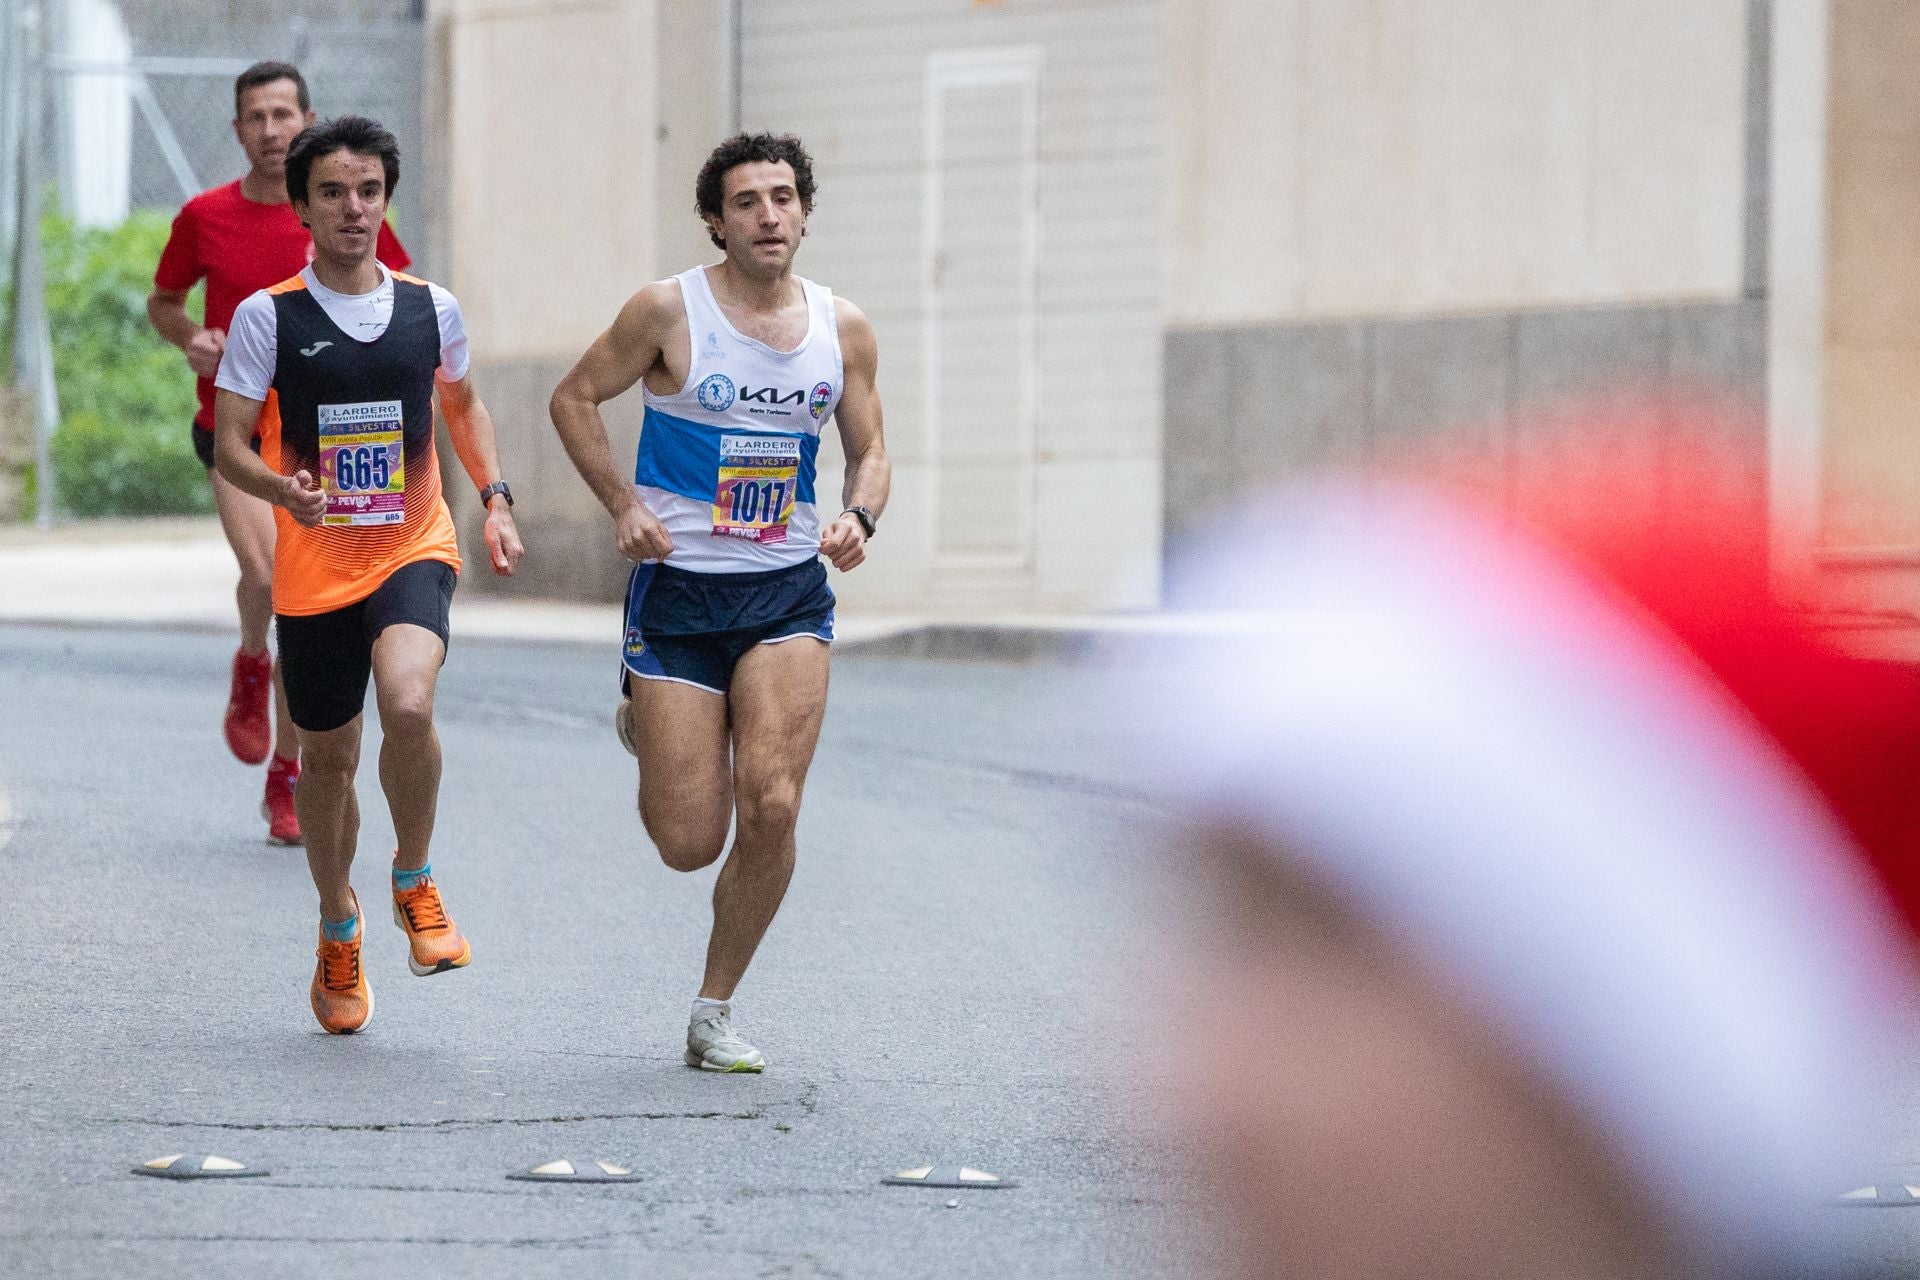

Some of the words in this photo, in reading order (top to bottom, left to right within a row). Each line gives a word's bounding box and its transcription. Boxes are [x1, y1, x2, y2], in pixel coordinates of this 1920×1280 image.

[740, 385, 805, 406] KIA
[331, 412, 399, 422] ayuntamiento
[333, 405, 397, 417] LARDERO
[735, 441, 795, 449] LARDERO
[336, 446, 390, 491] 665
[338, 495, 371, 508] PEVISA
[730, 481, 786, 523] 1017
[385, 513, 399, 521] 665
